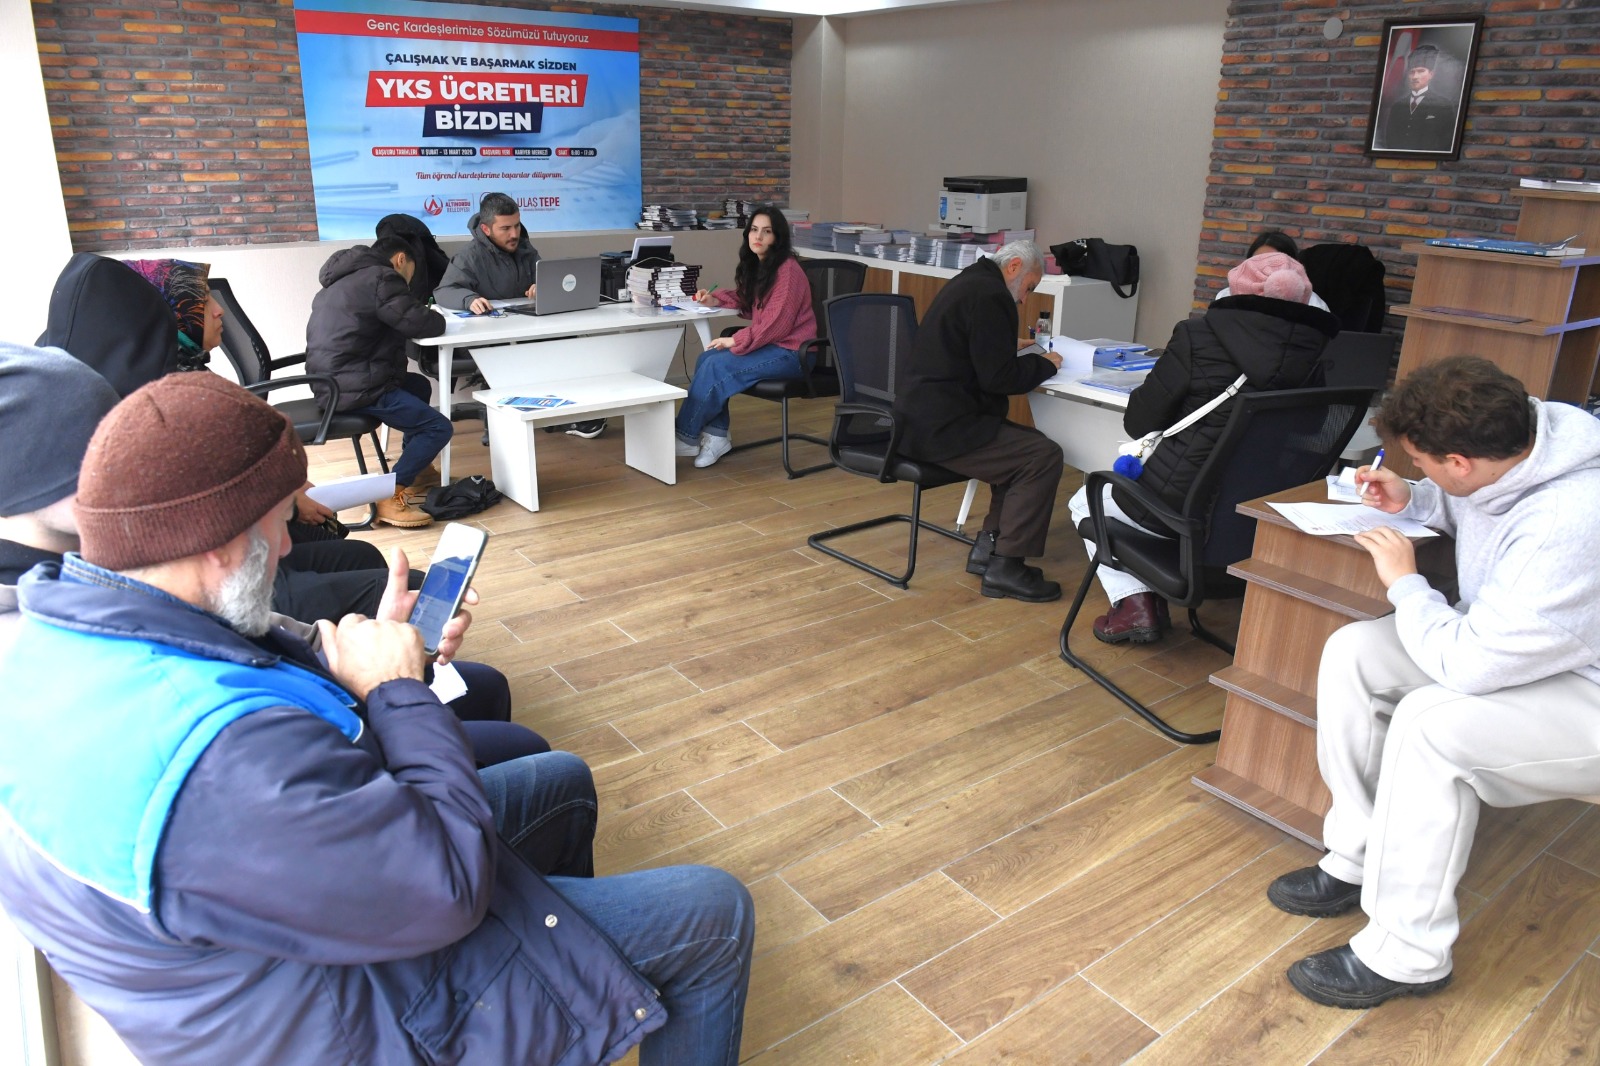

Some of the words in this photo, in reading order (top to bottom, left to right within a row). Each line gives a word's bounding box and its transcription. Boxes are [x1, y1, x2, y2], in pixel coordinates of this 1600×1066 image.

[366, 18, 400, 34] Genç
[404, 21, 485, 37] Kardeşlerimize
[487, 26, 541, 40] Sözümüzü
[542, 29, 589, 44] Tutuyoruz
[385, 53, 449, 67] ÇALIŞMAK
[452, 56, 468, 66] VE
[470, 57, 535, 70] BAŞARMAK
[537, 58, 577, 71] SİZDEN
[376, 78, 432, 100] YKS
[439, 75, 578, 104] ÜCRETLERİ
[435, 104, 532, 131] BİZDEN
[415, 171, 431, 180] Tüm
[432, 172, 457, 181] öğrenci
[458, 172, 500, 181] kardeşlerime
[502, 172, 531, 180] başarılar
[532, 172, 564, 181] diliyorum.
[539, 196, 560, 207] TEPE
